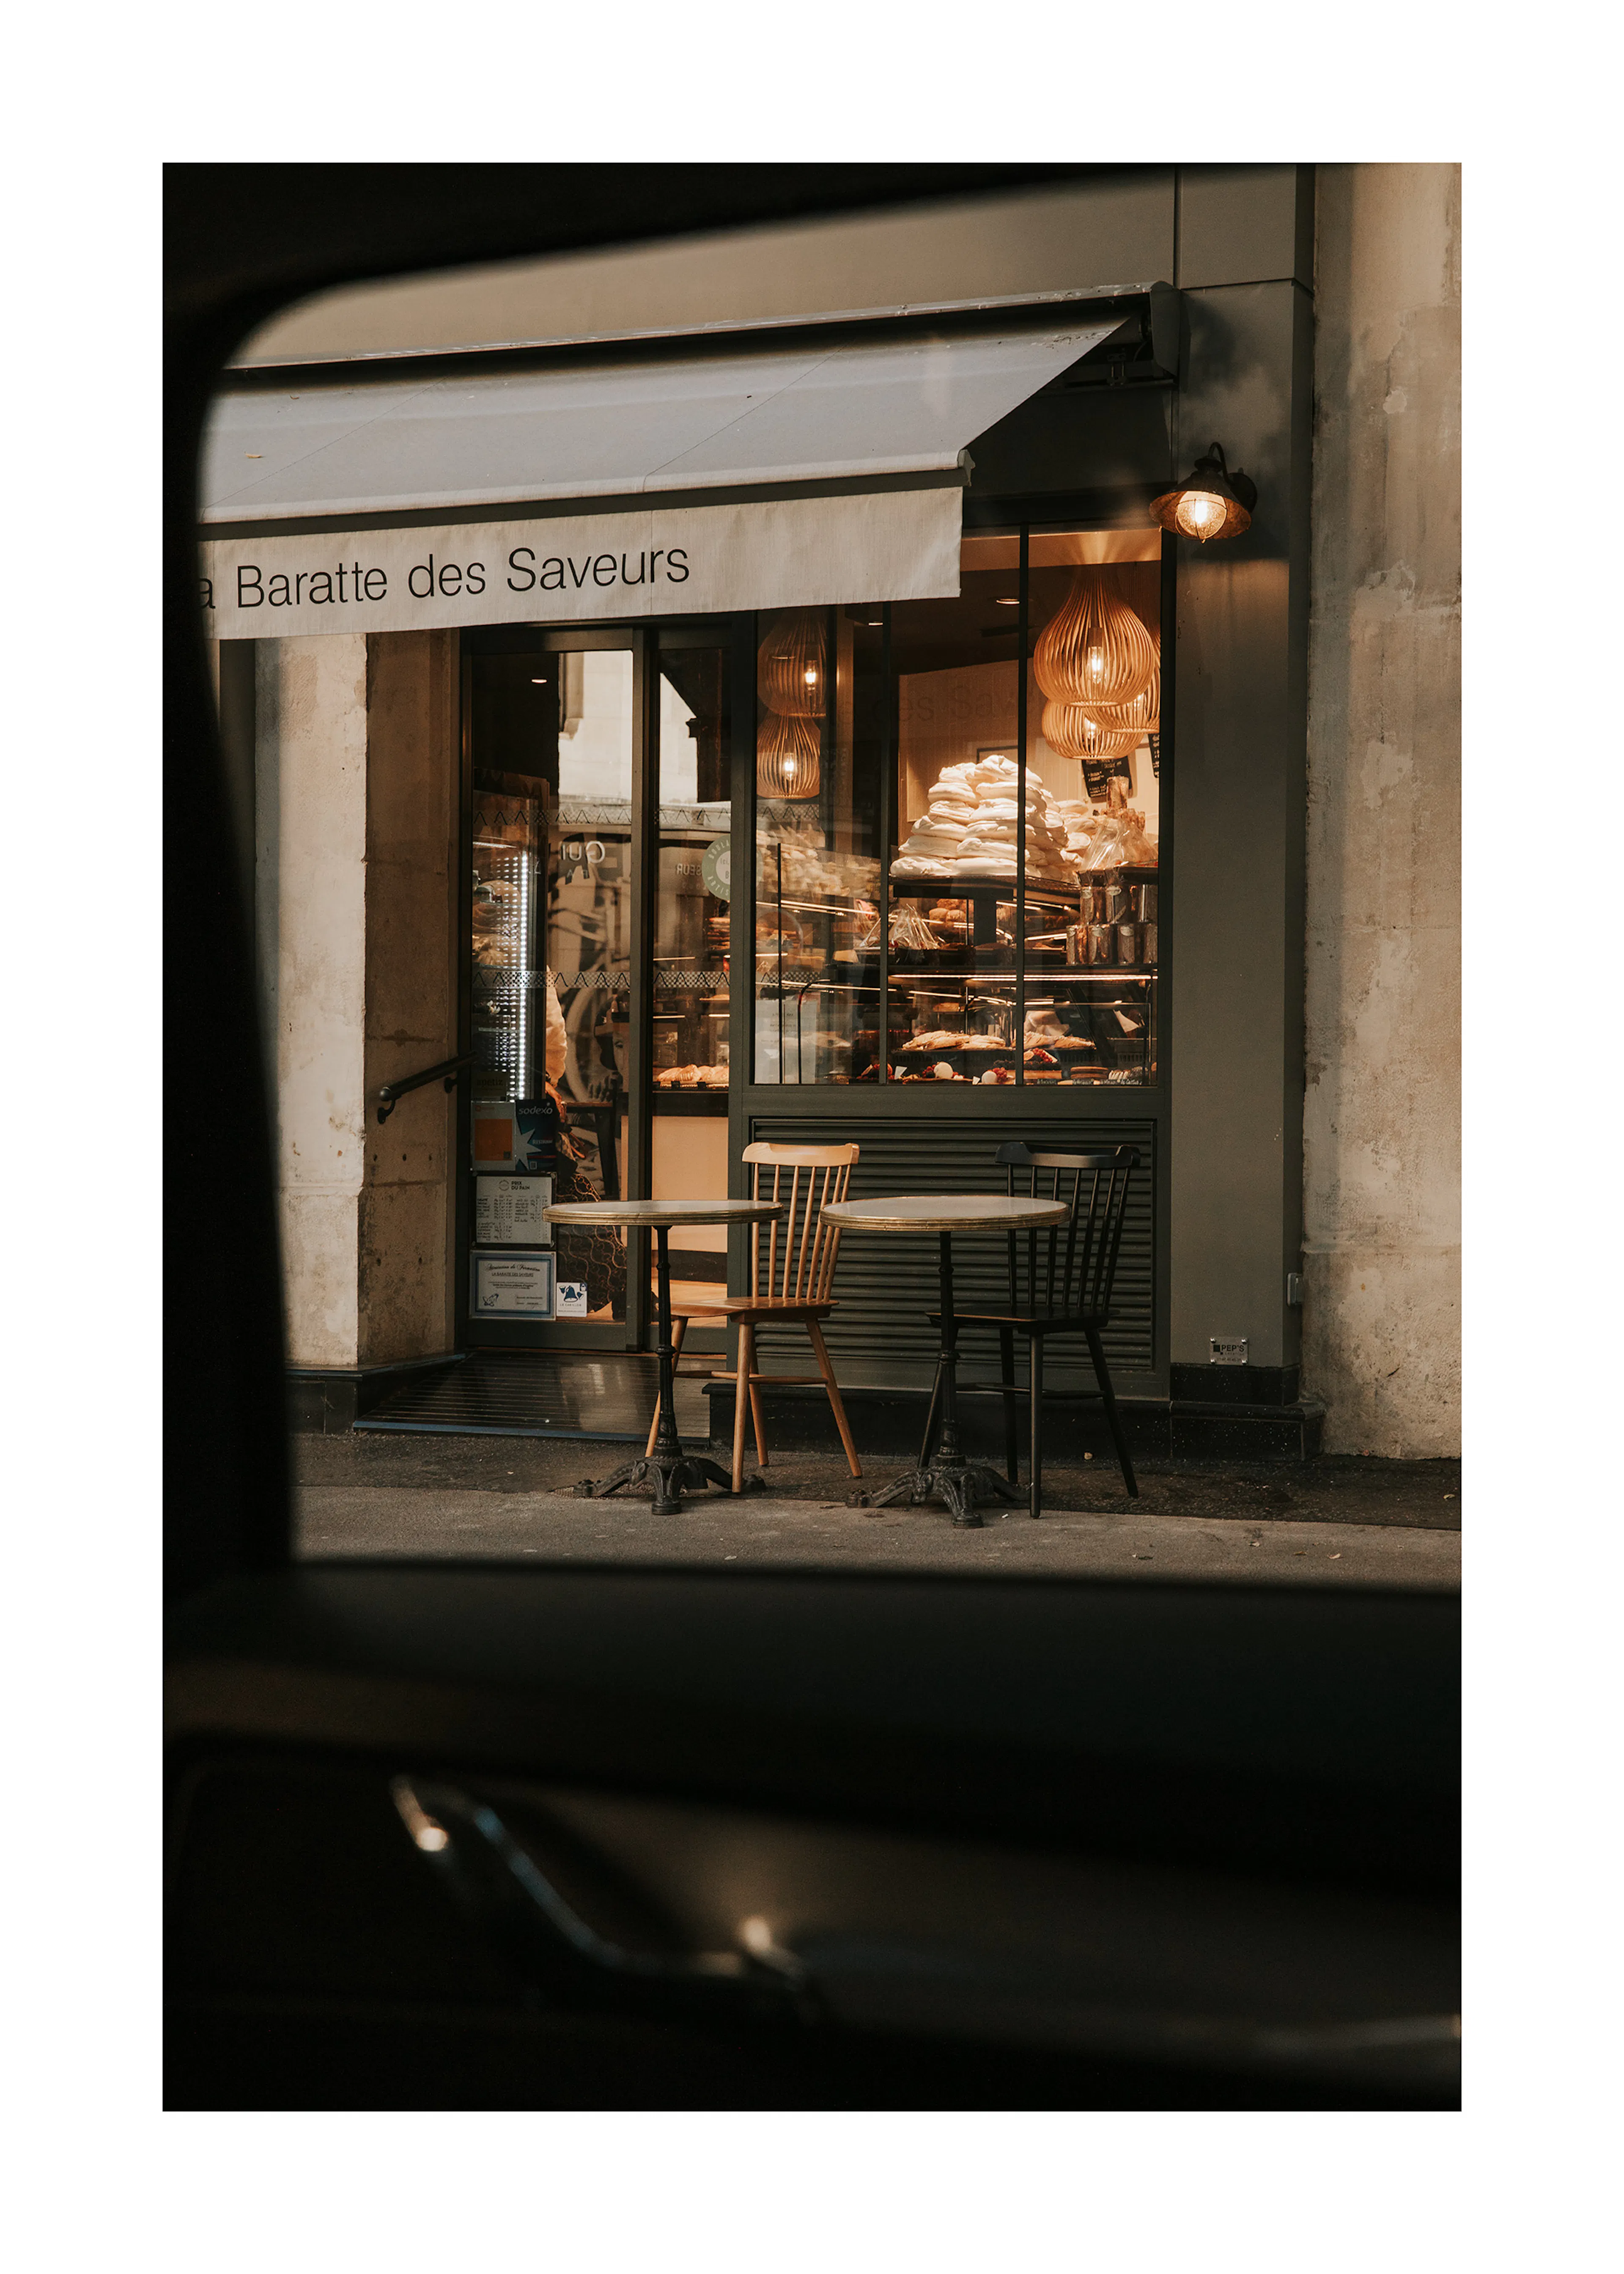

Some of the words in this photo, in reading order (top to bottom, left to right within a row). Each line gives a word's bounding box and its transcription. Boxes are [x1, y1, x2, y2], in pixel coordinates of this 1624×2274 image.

[237, 561, 388, 608] Baratte
[408, 554, 486, 599] des
[507, 547, 690, 592] Saveurs
[518, 1106, 553, 1115] sodexo
